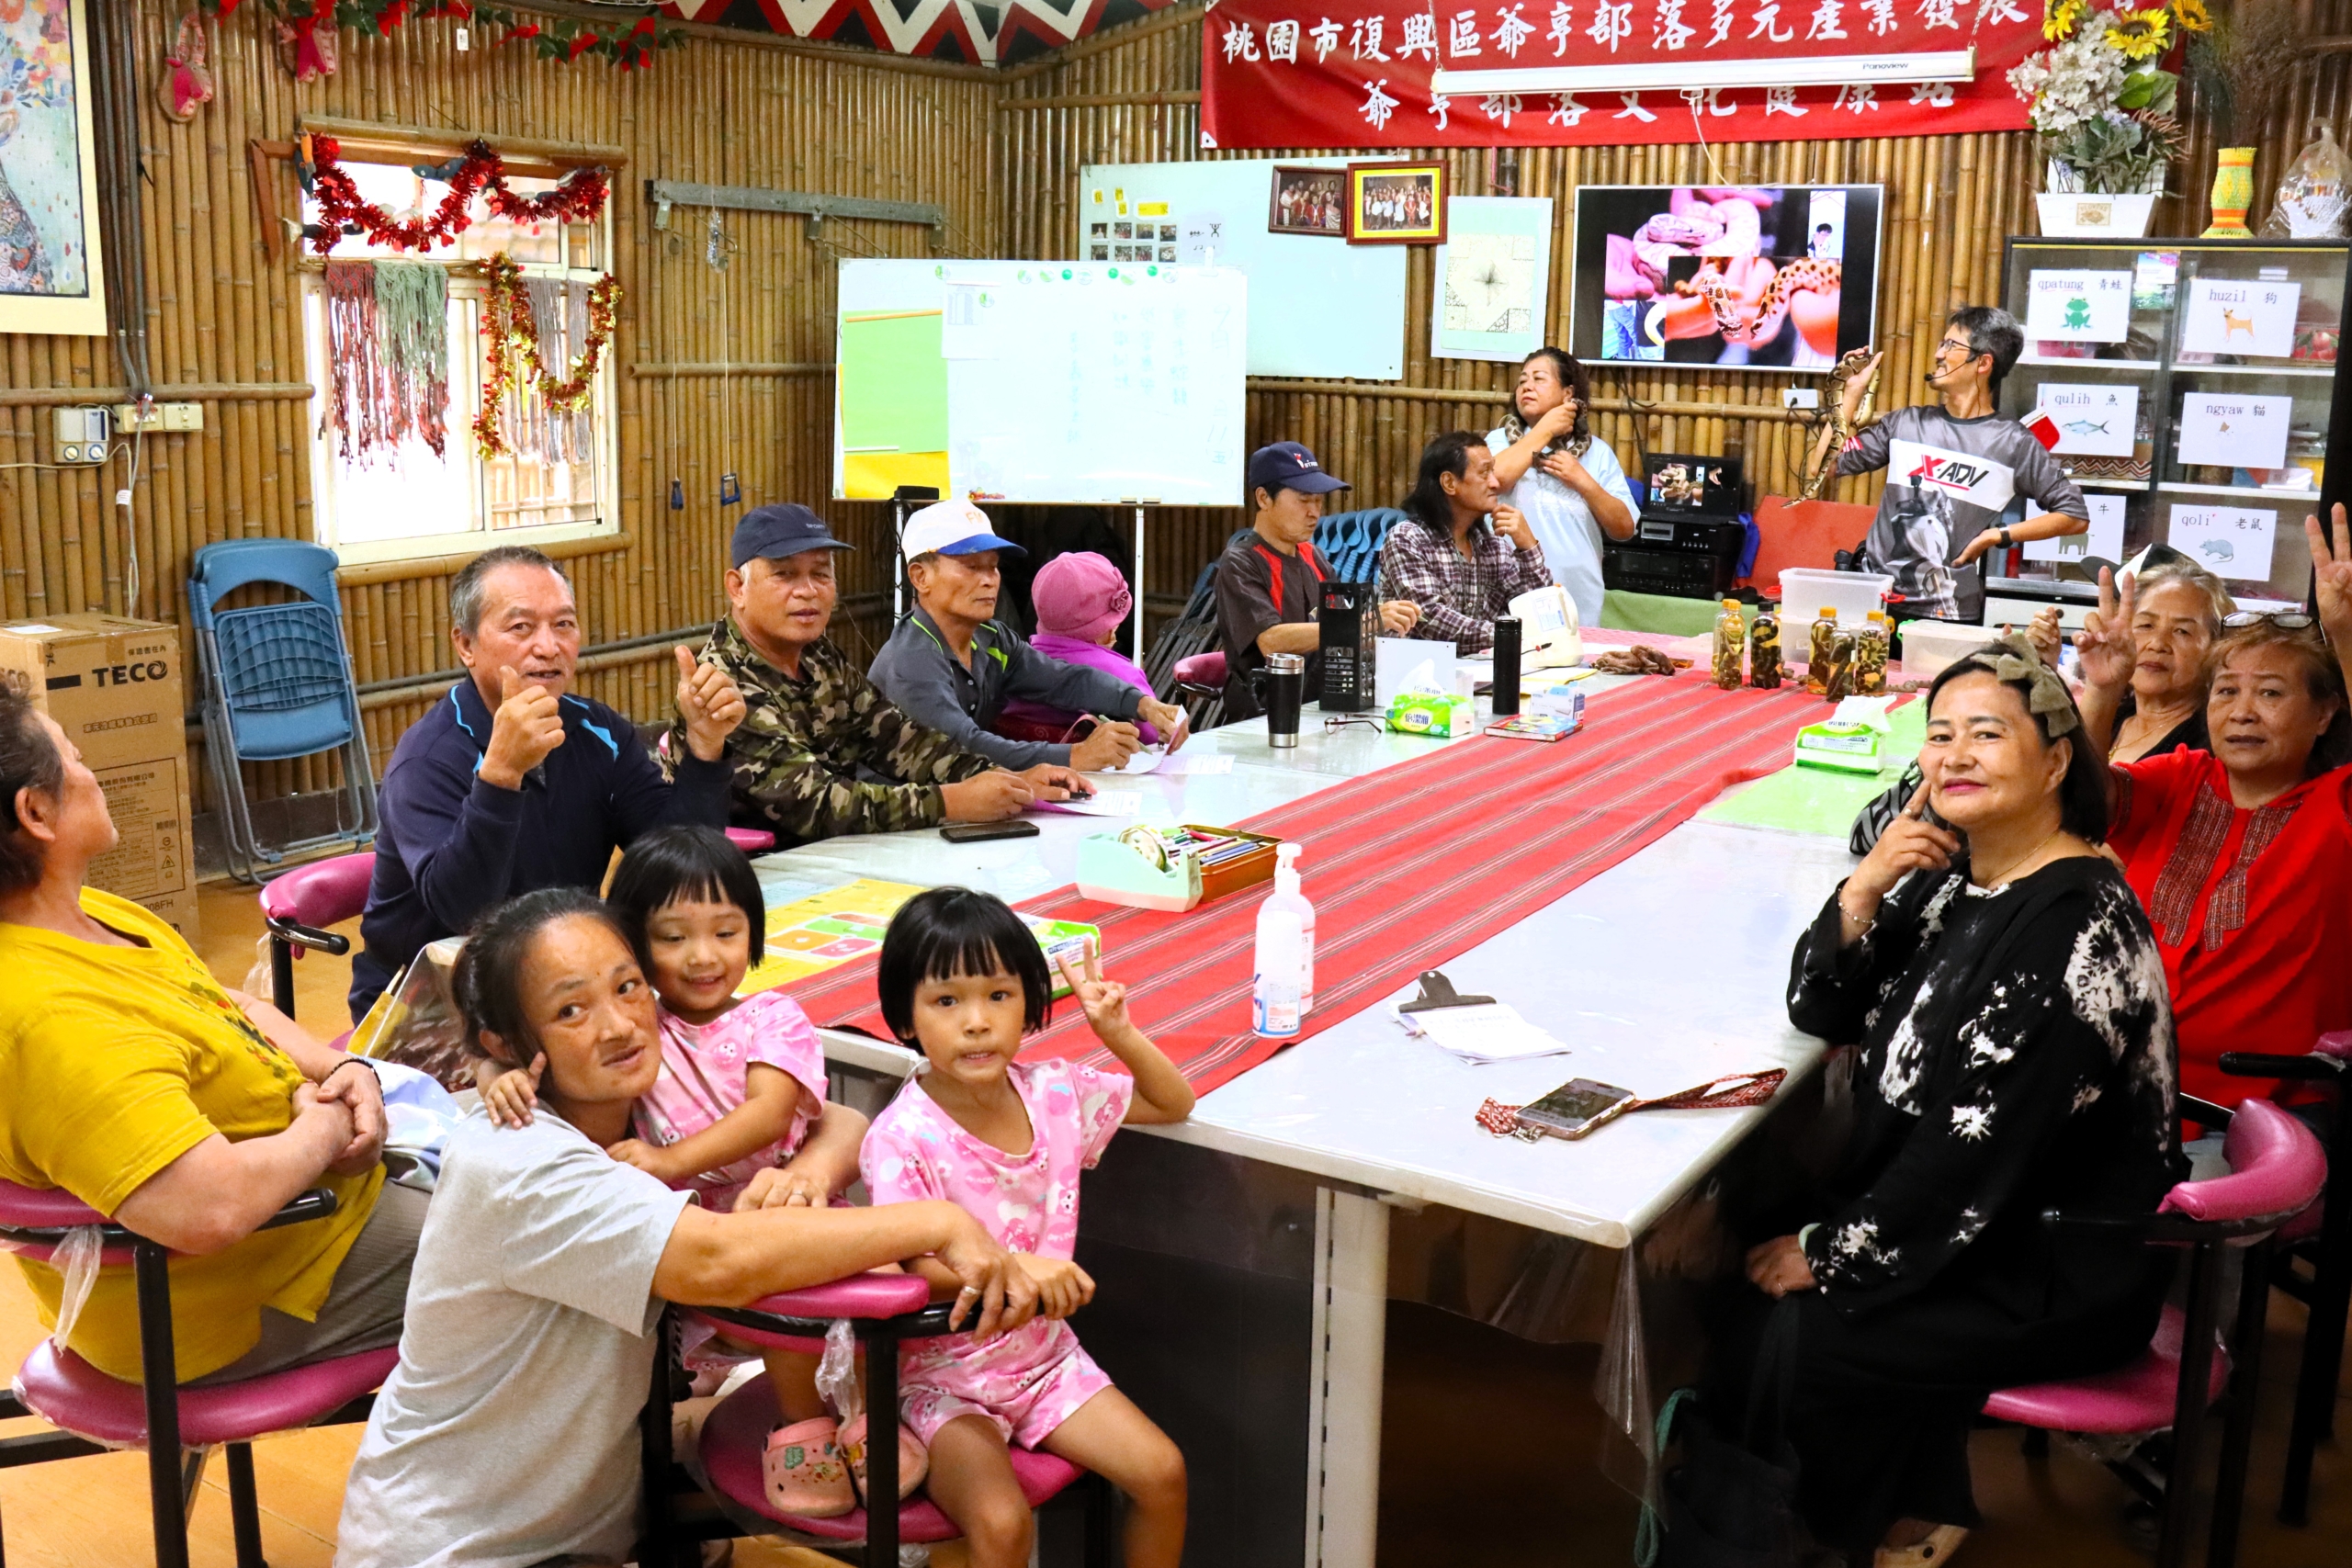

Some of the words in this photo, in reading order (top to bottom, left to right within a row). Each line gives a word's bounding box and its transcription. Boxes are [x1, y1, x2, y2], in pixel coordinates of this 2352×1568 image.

[2038, 279, 2084, 290] qpatung
[2098, 278, 2122, 290] 青蛙
[2209, 288, 2246, 302] huzil
[2264, 292, 2277, 304] 狗
[2054, 392, 2090, 405] qulih
[2106, 393, 2118, 406] 魚
[2206, 404, 2244, 416] ngyaw
[2253, 404, 2266, 416] 貓
[2098, 503, 2109, 515] 牛
[2235, 516, 2262, 531] 老鼠
[91, 660, 168, 688] TECO
